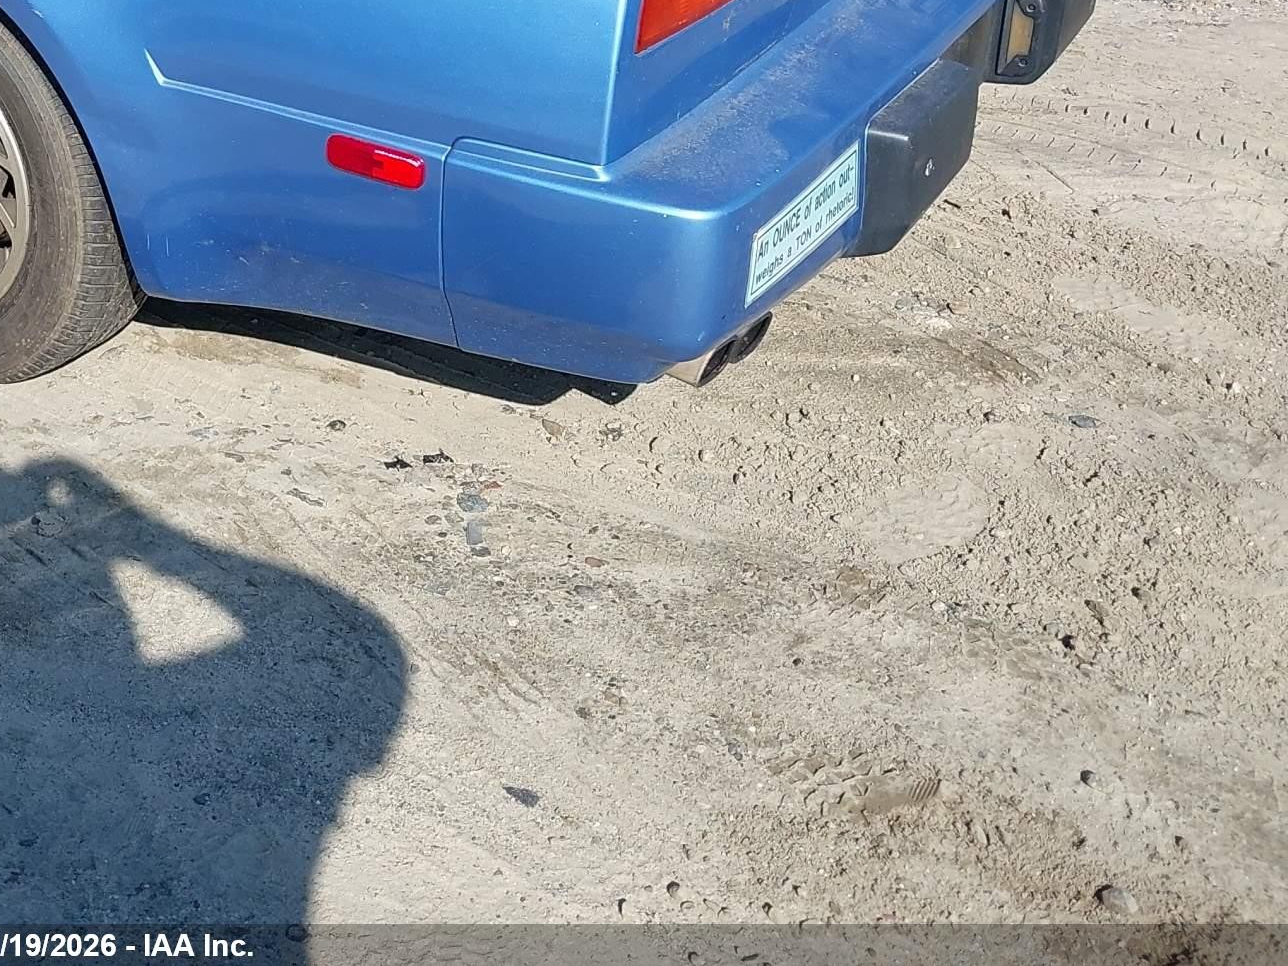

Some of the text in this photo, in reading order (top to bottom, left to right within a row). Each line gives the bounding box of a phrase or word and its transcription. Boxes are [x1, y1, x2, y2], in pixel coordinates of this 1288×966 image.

[755, 186, 854, 285] weighs a TON of rhetoric!
[757, 163, 854, 260] An OUNCE of action out-
